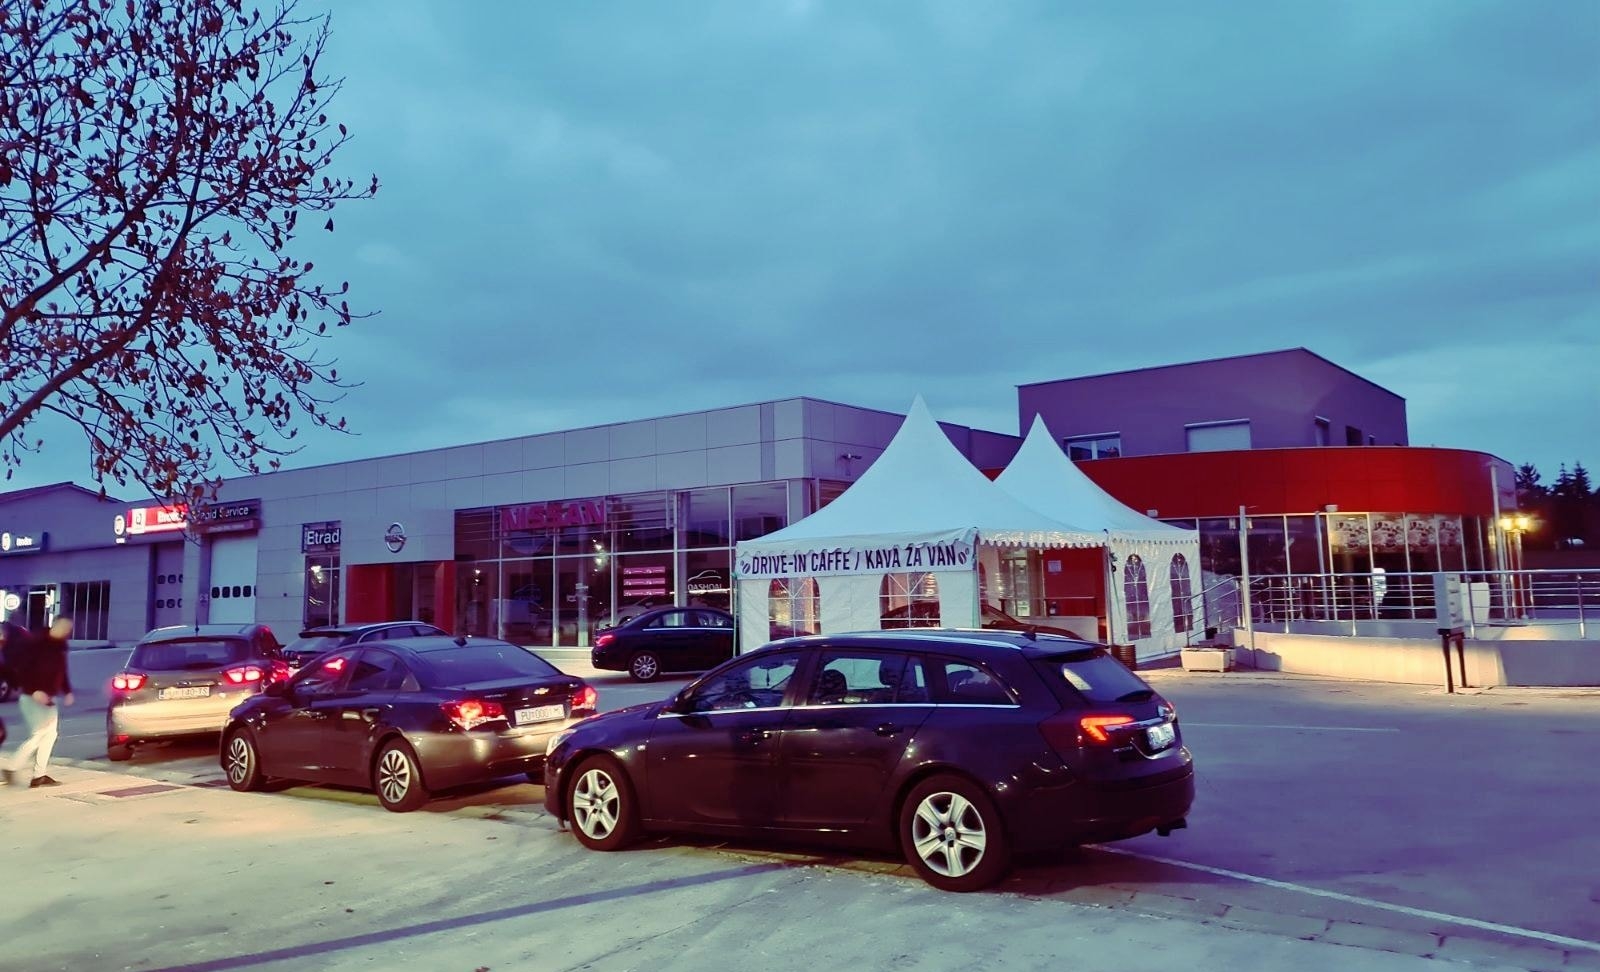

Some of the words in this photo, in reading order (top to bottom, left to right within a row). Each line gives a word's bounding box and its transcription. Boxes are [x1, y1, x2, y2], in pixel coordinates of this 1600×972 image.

[501, 501, 605, 531] NISSAN
[306, 528, 340, 545] Etrad
[752, 554, 806, 574] DRIVE-IN
[811, 551, 850, 572] CAFFE
[865, 548, 901, 569] KAVA
[905, 546, 922, 567] ZA
[927, 544, 956, 566] VAN
